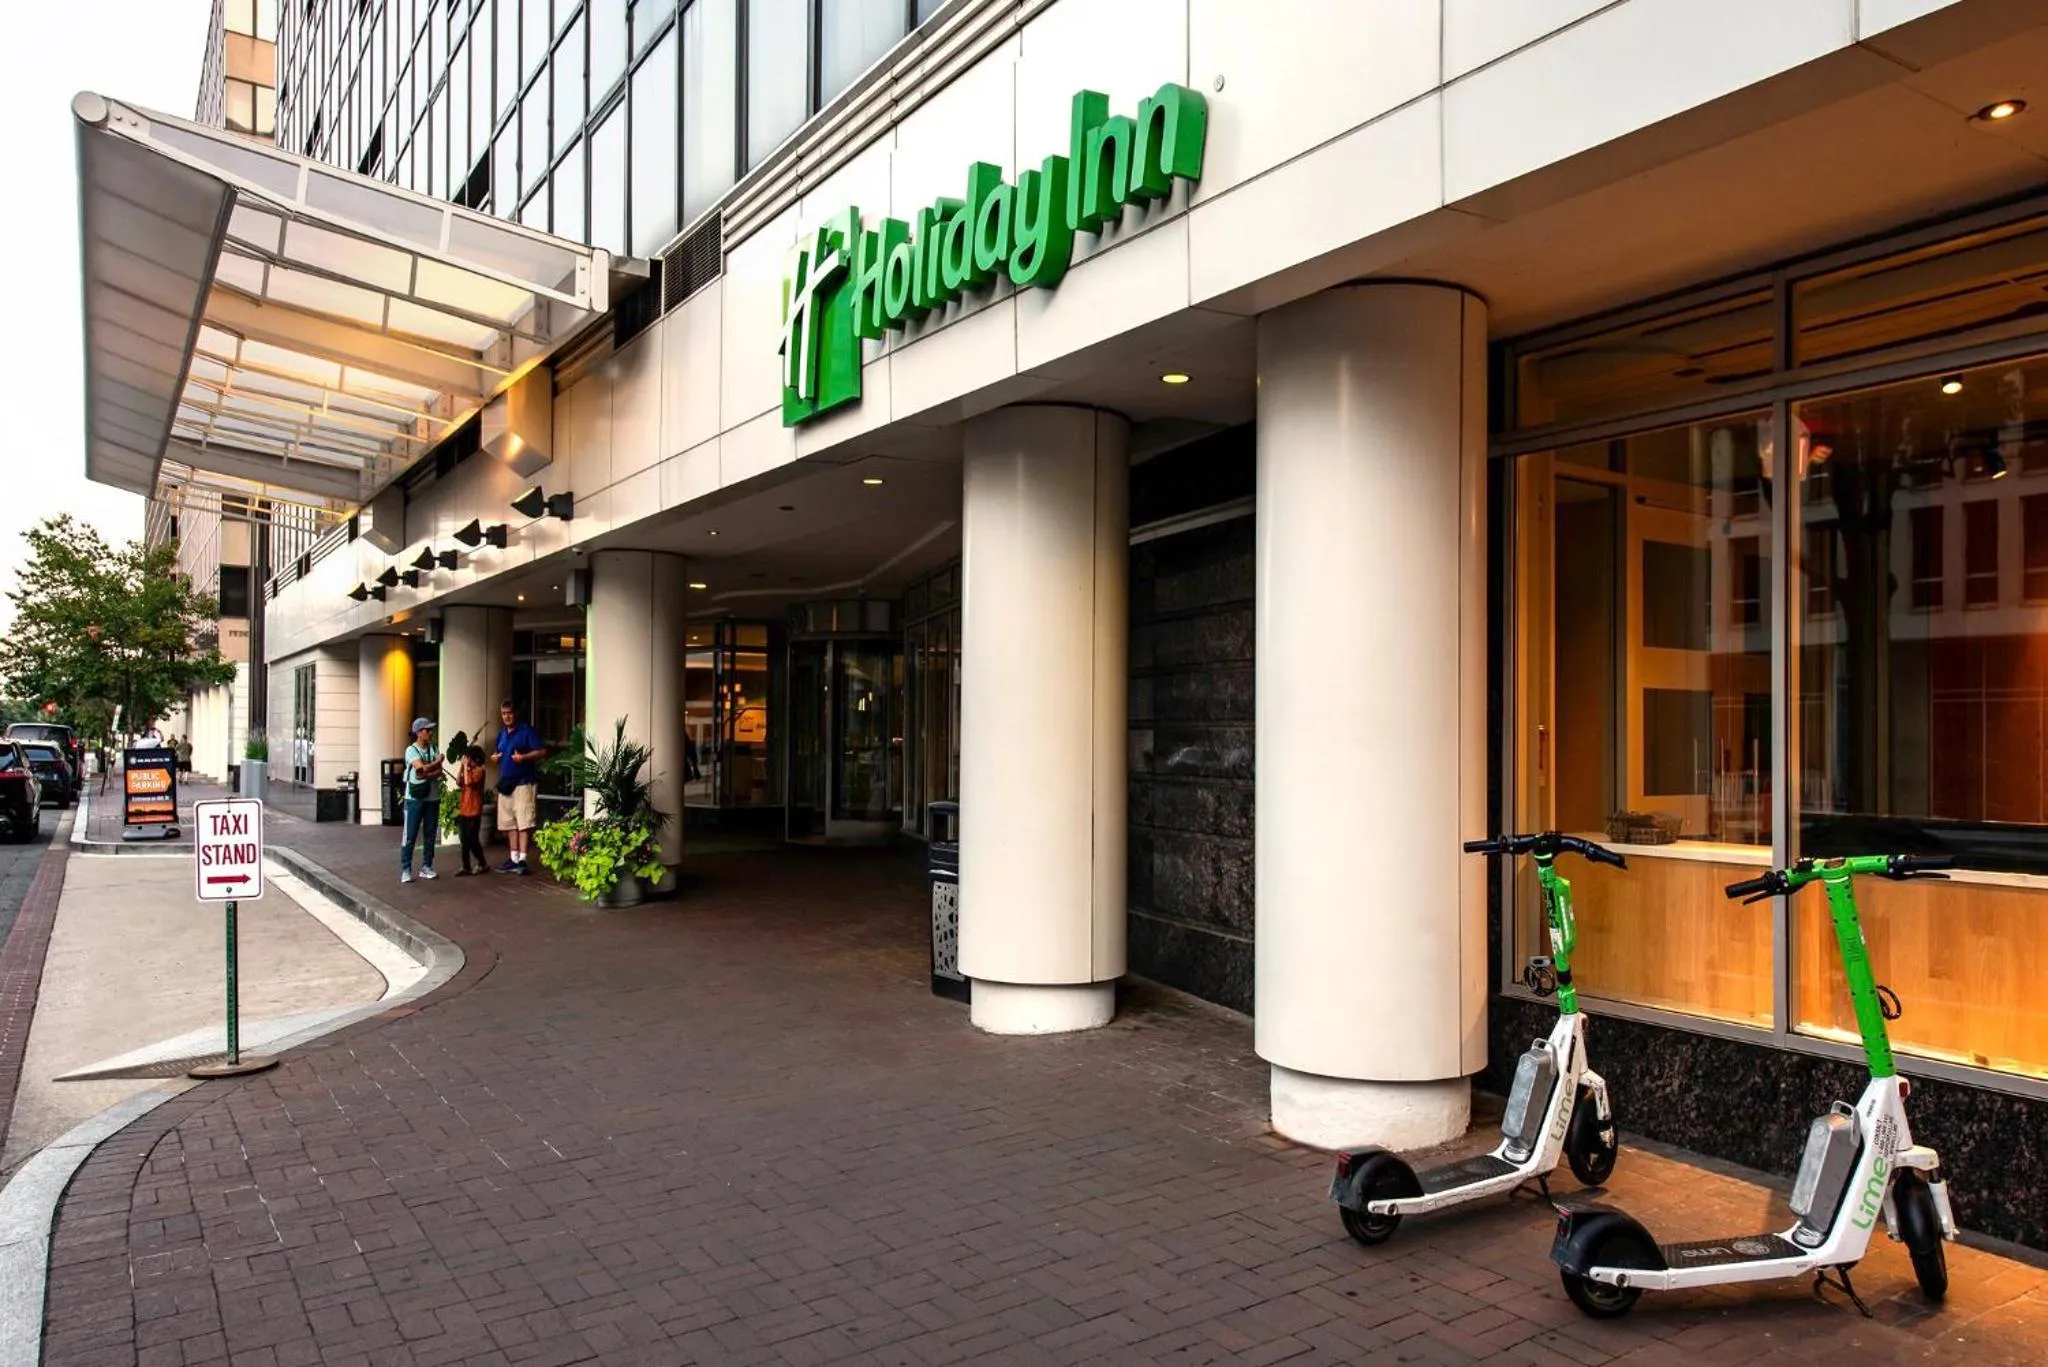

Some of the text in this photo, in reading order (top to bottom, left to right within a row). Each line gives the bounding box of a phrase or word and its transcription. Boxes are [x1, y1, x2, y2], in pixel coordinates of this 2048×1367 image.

[851, 83, 1208, 338] Holiday Inn
[131, 780, 166, 790] PARKING
[210, 814, 248, 836] TAXI
[202, 843, 256, 866] STAND
[1551, 1078, 1574, 1141] Lime
[1852, 1156, 1889, 1230] Lime
